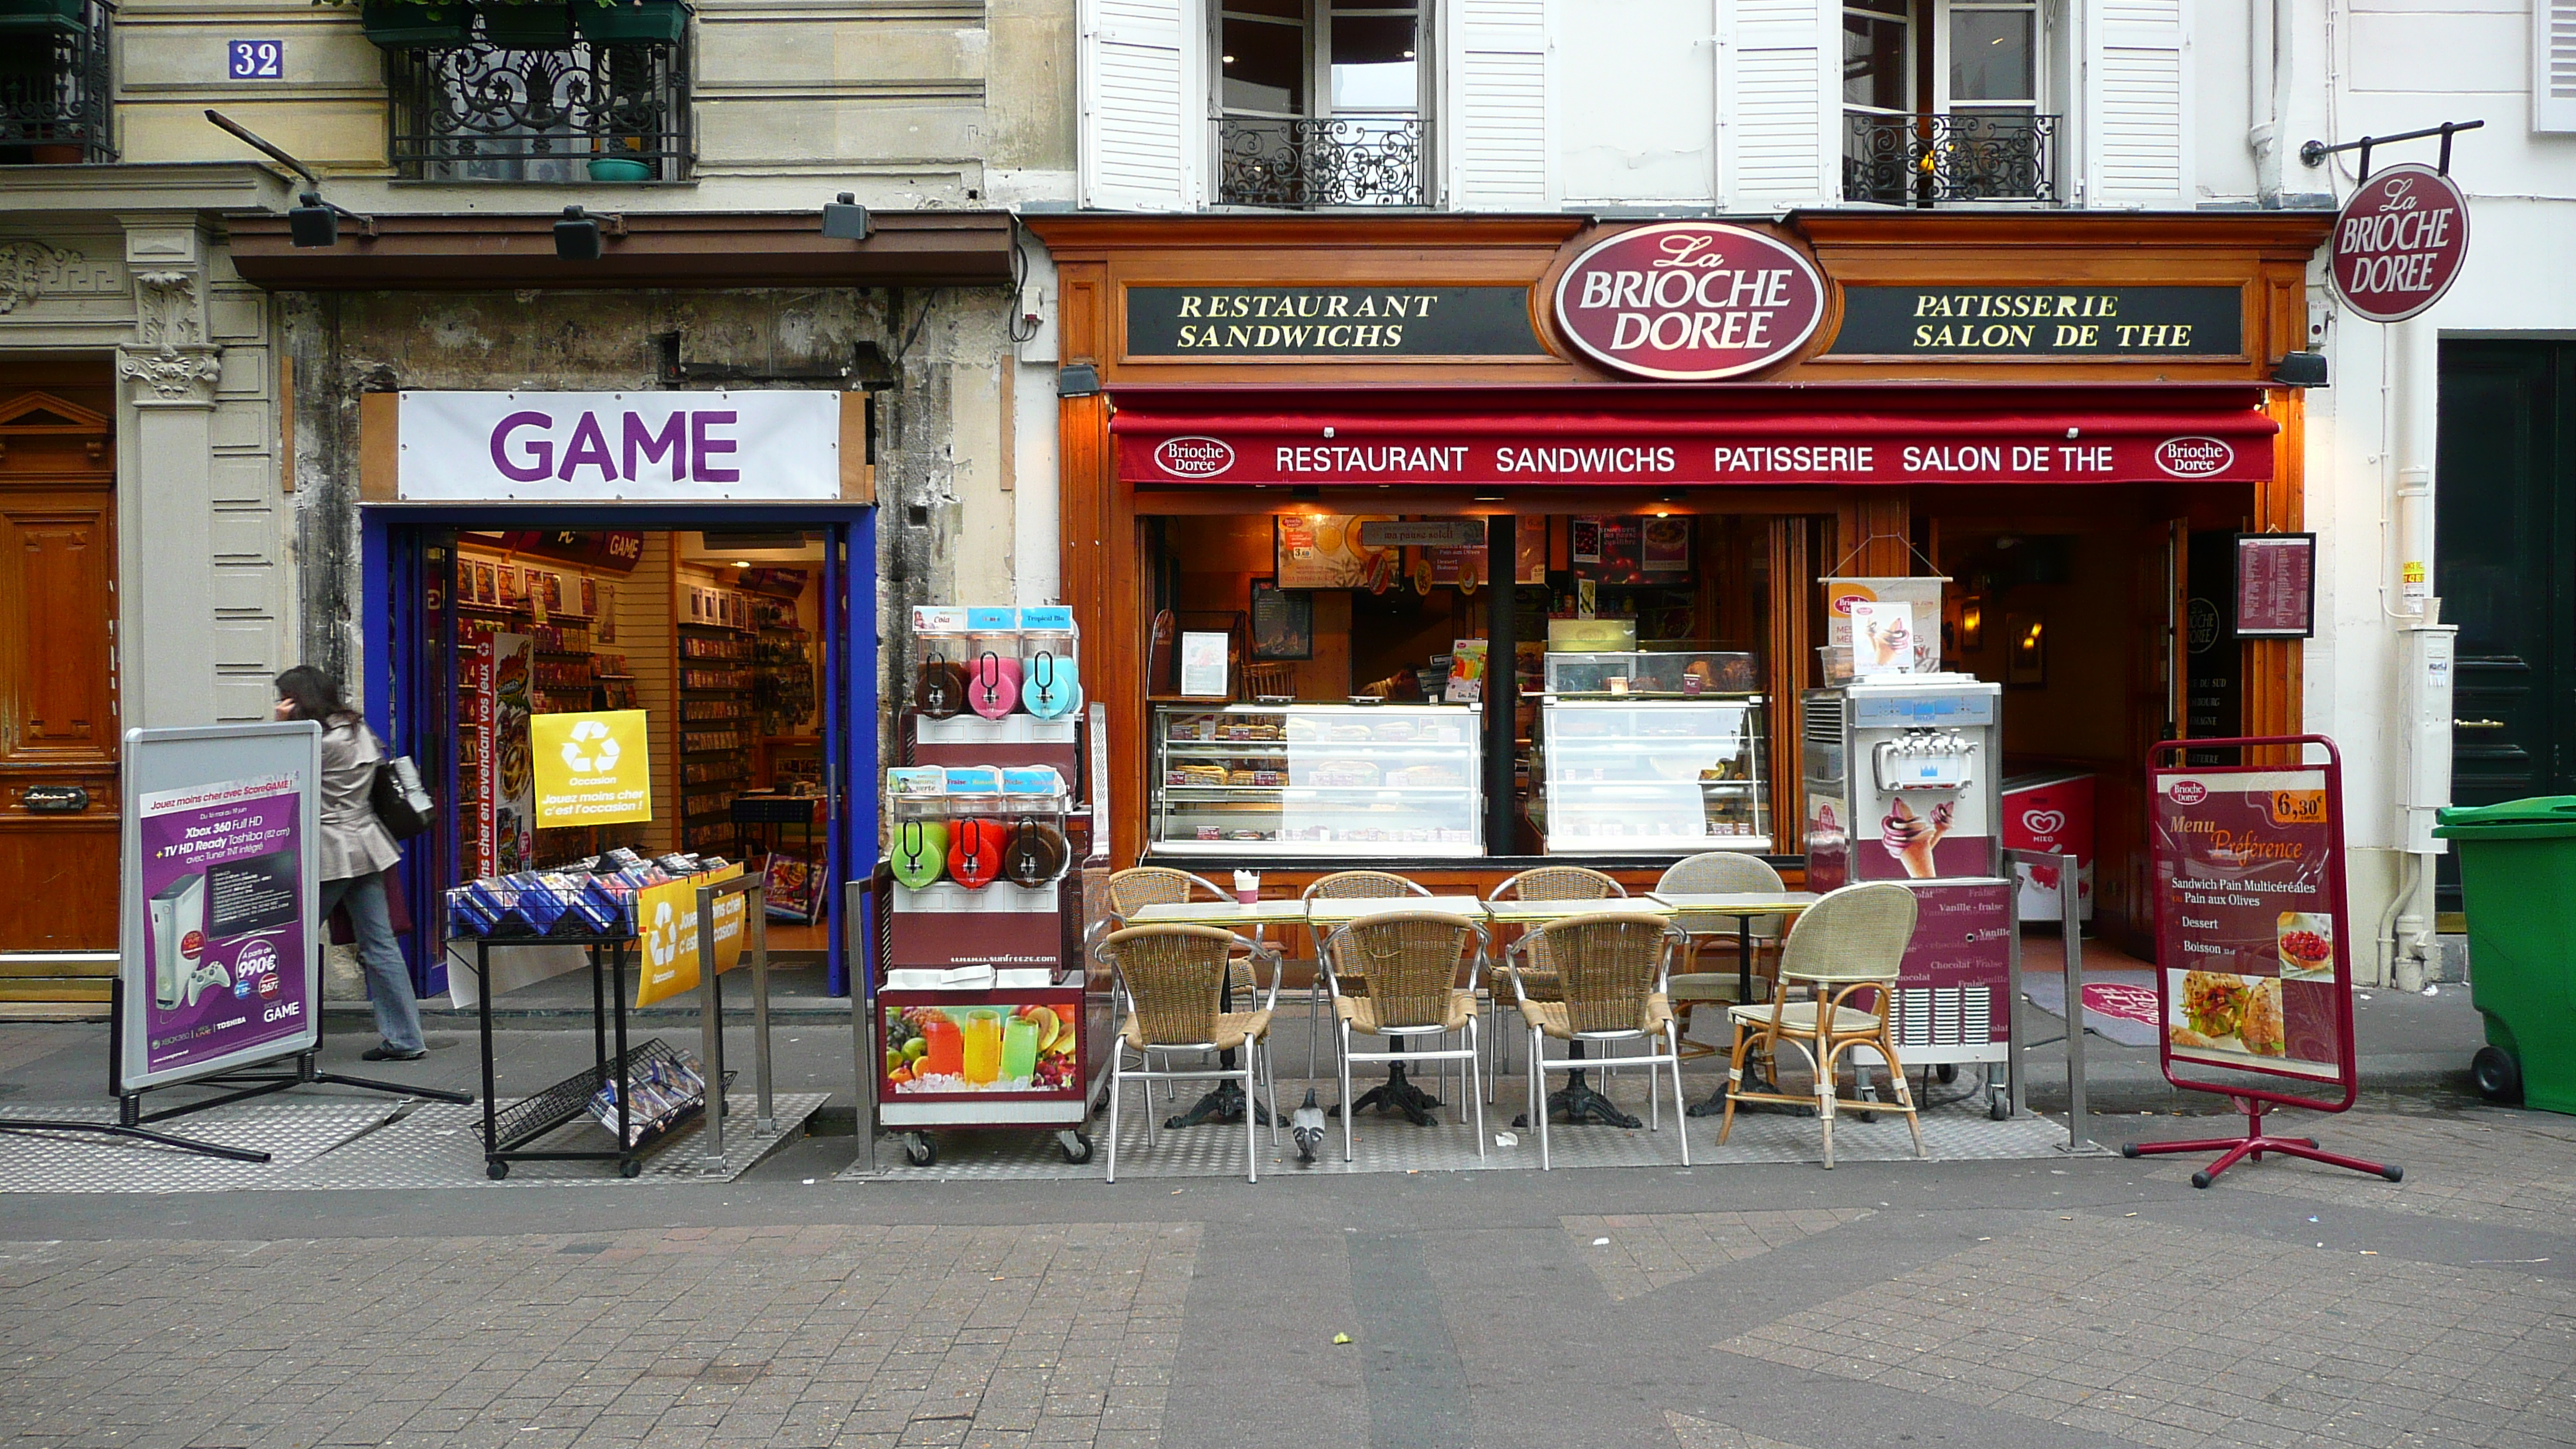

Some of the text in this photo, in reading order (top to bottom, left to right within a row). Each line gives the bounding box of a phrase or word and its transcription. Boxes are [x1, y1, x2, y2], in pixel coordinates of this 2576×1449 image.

[235, 43, 277, 75] 32
[2379, 178, 2417, 212] La
[2339, 207, 2454, 255] BRIOCHE
[1652, 234, 1725, 269] La
[2349, 253, 2437, 294] DOREE
[1578, 269, 1793, 309] BRIOCHE
[1177, 294, 1438, 319] RESTAURANT
[1913, 294, 2119, 317] PATISSERIE
[1177, 324, 1403, 348] SANDWICHS
[1609, 311, 1774, 351] DOREE
[1913, 324, 2193, 348] SALON DE THE
[490, 410, 740, 482] GAME
[1167, 442, 1224, 459] Brioche
[2167, 442, 2224, 460] Brioche
[1276, 446, 2113, 472] RESTAURANT SANDWICHS PATISSERIE SALON DE THE
[609, 534, 639, 560] GAME
[933, 615, 951, 624] Cola
[467, 626, 473, 639] 2
[469, 665, 475, 678] 4
[477, 663, 492, 697] jeux
[2211, 678, 2227, 688] SUD
[480, 697, 490, 722] vos
[478, 724, 490, 802] revendant
[569, 776, 617, 786] Occasion
[2174, 784, 2203, 795] Brioche
[150, 799, 176, 810] Jouez
[176, 794, 201, 807] moins
[203, 792, 222, 802] cher
[223, 789, 242, 799] avec
[244, 780, 289, 794] ScoreGAME
[542, 789, 644, 805] Jouez moins cher
[480, 806, 490, 820] en
[544, 805, 574, 817] c'est
[185, 815, 263, 839] Xbox 360 Full HD
[2170, 816, 2215, 834] Menu
[165, 845, 178, 858] TV
[179, 842, 194, 855] HD
[195, 838, 227, 851] Ready
[229, 831, 263, 845] Toshiba
[478, 823, 490, 856] cher
[2210, 830, 2303, 866] Préférence
[186, 855, 205, 865] avec
[206, 850, 225, 861] Tuner
[227, 847, 239, 857] TNT
[2171, 877, 2316, 894] Sandwich Pain Multicéréales
[1939, 903, 1971, 912] Vanille
[1978, 902, 2004, 911] fraise
[2172, 892, 2260, 906] ou Pain aux Olives
[679, 897, 742, 930] Joue ins cher
[2182, 916, 2218, 930] Dessert
[1979, 928, 2011, 937] Vanille
[248, 949, 262, 959] partir
[263, 946, 272, 955] de
[2184, 940, 2221, 954] Boisson
[238, 954, 277, 978] 990€
[951, 954, 1057, 963] www.sunfreeze.com
[1930, 961, 1971, 970] Chocolat
[1958, 980, 1986, 988] Fraise
[216, 1016, 246, 1030] TOSHIBA
[263, 1002, 300, 1023] GAME
